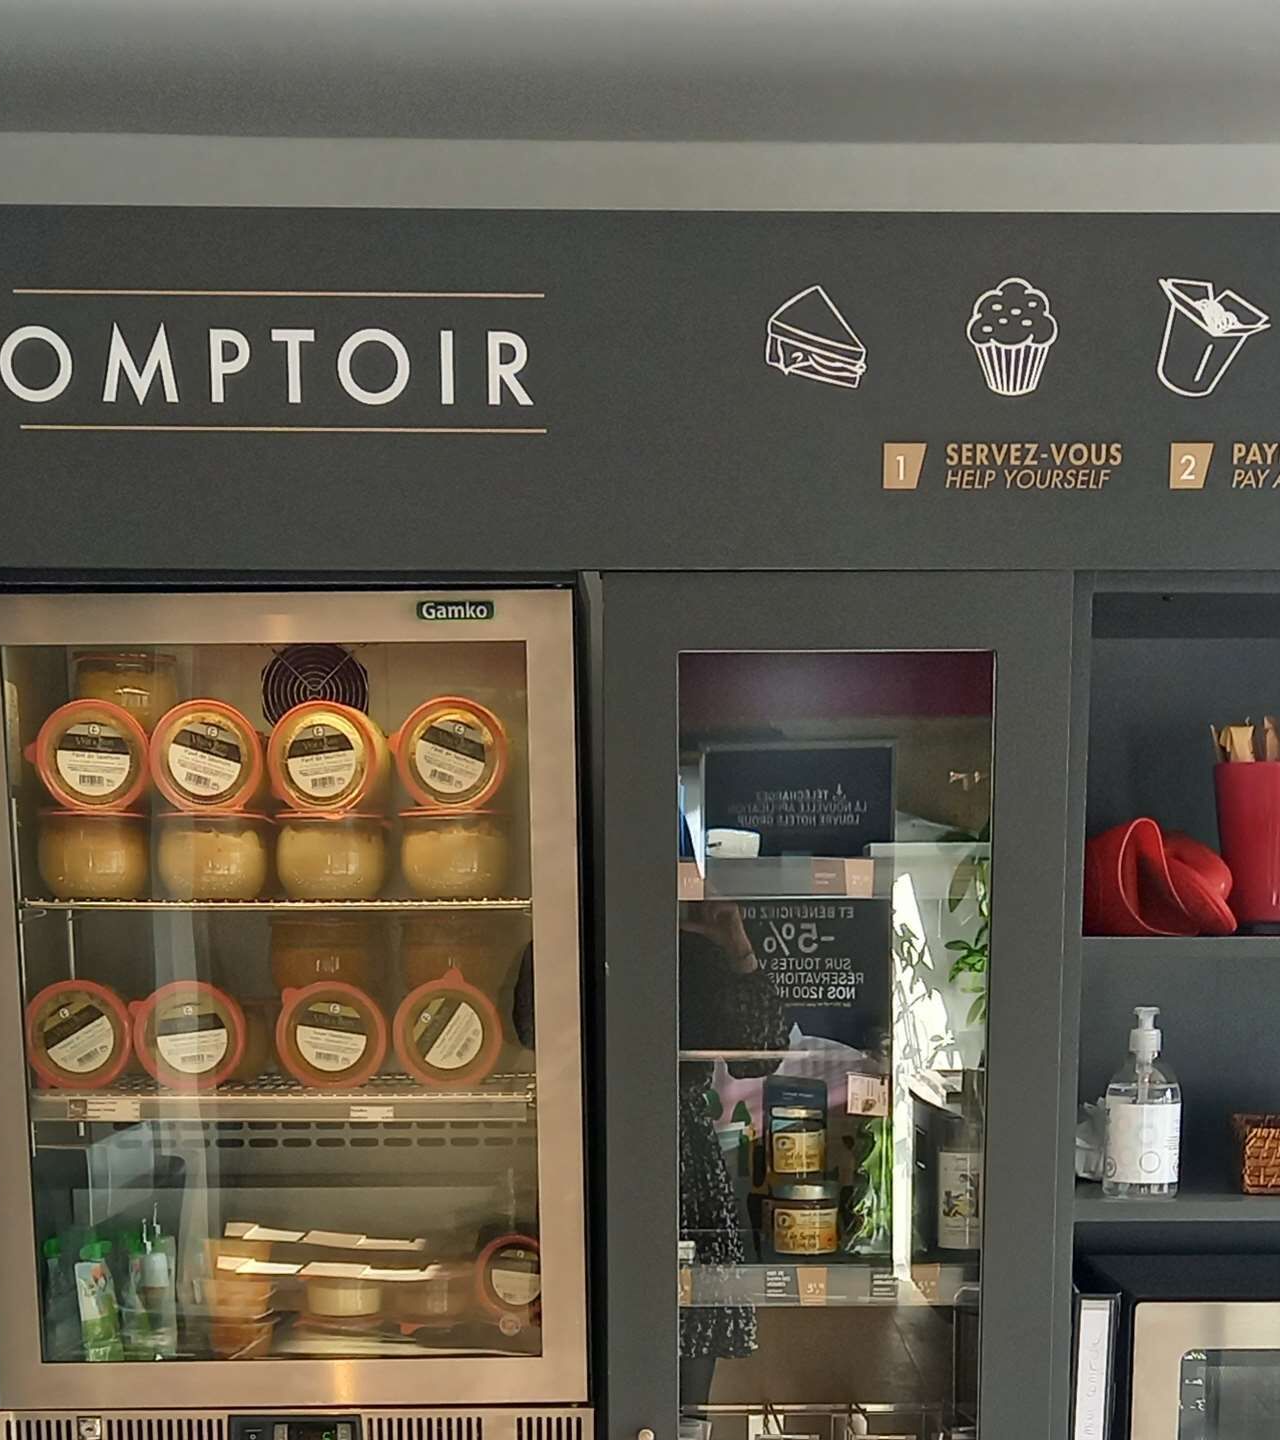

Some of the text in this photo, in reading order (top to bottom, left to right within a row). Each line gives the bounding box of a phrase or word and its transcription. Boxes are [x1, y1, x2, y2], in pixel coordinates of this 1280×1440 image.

[945, 443, 1122, 466] SERVEZ-VOUS
[895, 455, 905, 481] 1
[1179, 455, 1196, 481] 2
[945, 469, 1111, 489] HELP YOURSELF
[1232, 469, 1270, 489] PAY
[422, 601, 488, 619] Gamko
